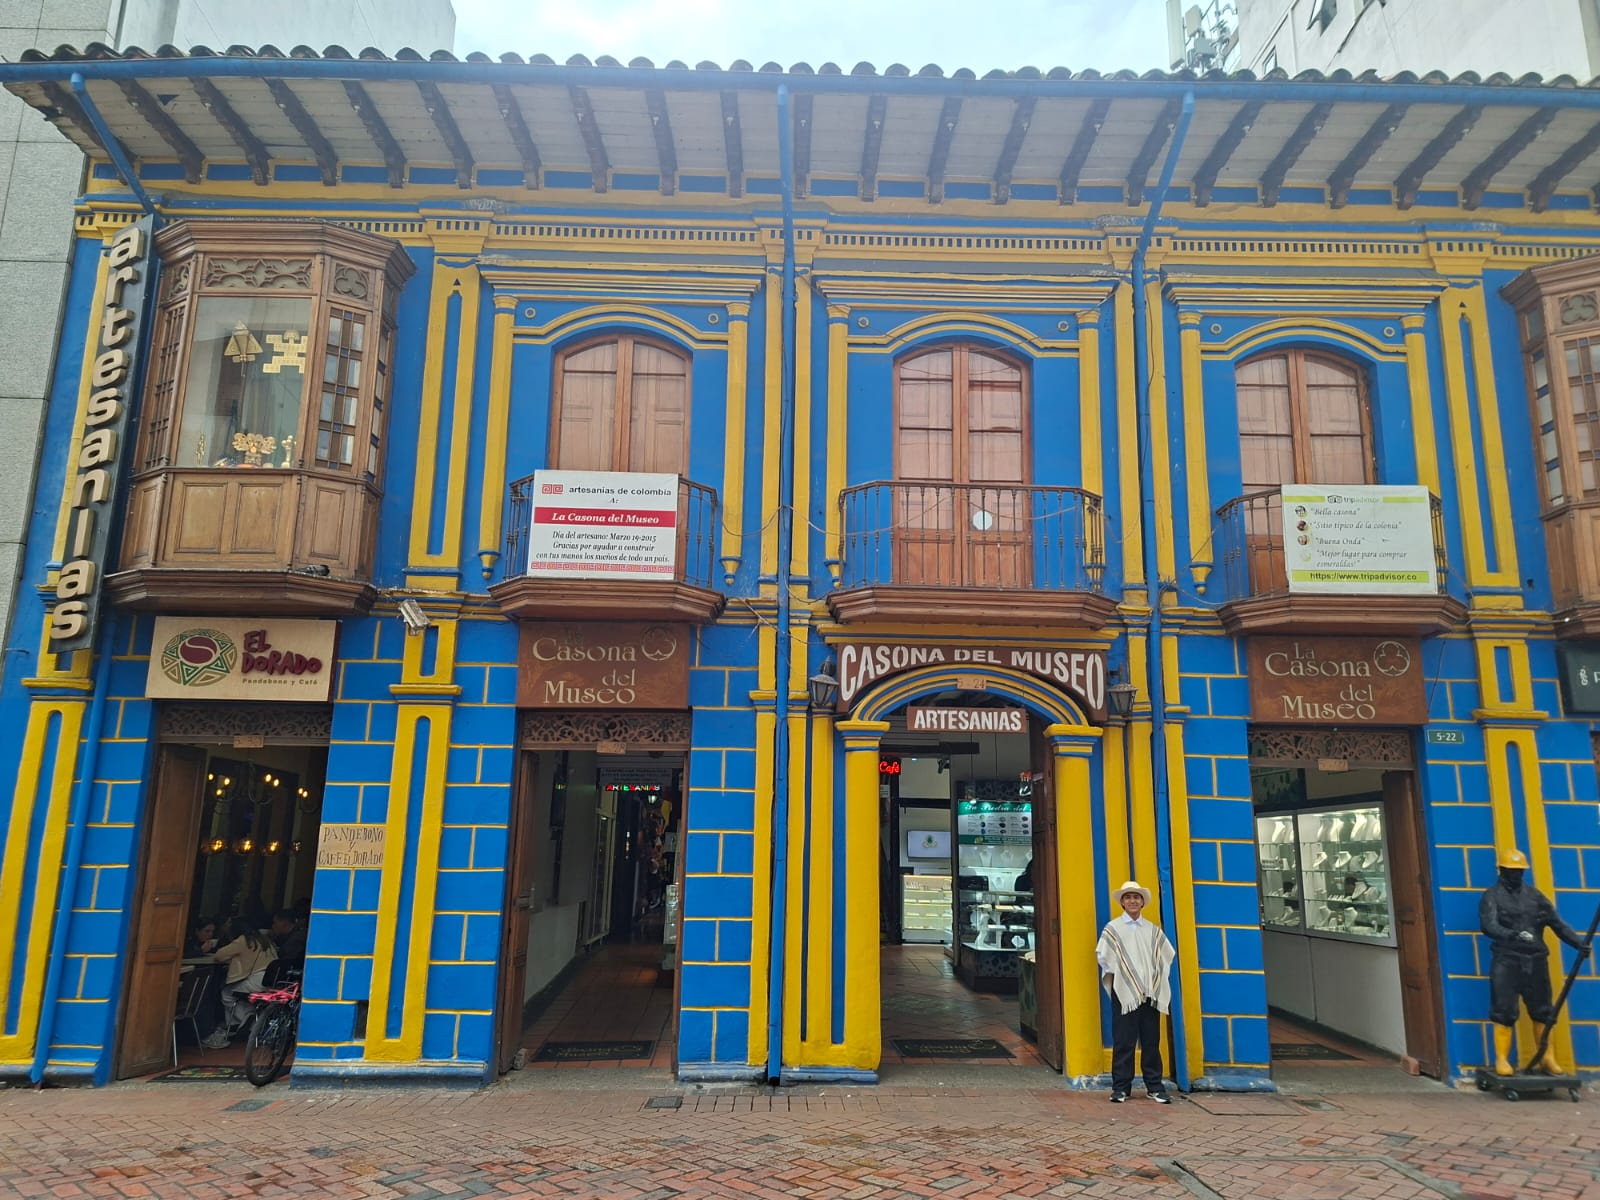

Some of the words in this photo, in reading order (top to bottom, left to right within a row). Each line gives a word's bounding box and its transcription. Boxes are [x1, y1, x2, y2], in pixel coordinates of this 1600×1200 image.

[617, 487, 629, 495] de
[631, 488, 672, 496] colombia
[551, 512, 565, 521] La
[567, 513, 605, 522] Casona
[608, 514, 624, 523] del
[625, 515, 660, 524] Museo
[564, 531, 576, 540] del
[609, 533, 630, 541] Marzo
[632, 534, 657, 542] 19-2015
[552, 542, 579, 550] Gracias
[580, 543, 591, 551] por
[593, 542, 617, 552] ayudar
[624, 542, 655, 552] construir
[1341, 549, 1360, 559] lugar
[1379, 552, 1407, 560] comprar
[561, 552, 583, 560] manos
[584, 552, 594, 560] los
[595, 553, 618, 561] sueños
[1310, 572, 1417, 581] https://www.tripadvisor.co
[244, 629, 272, 653] EL
[533, 637, 636, 662] Casona
[1294, 642, 1315, 660] La
[241, 650, 322, 675] DORADO
[1265, 652, 1371, 677] Casona
[602, 669, 635, 686] del
[841, 645, 946, 702] CASONA
[954, 649, 1002, 664] DEL
[1011, 651, 1104, 711] MUSEO
[543, 680, 636, 704] Museo
[1340, 684, 1374, 702] del
[1282, 695, 1376, 720] Museo
[914, 709, 1022, 731] ARTESANIAS
[1436, 732, 1457, 741] 5-22
